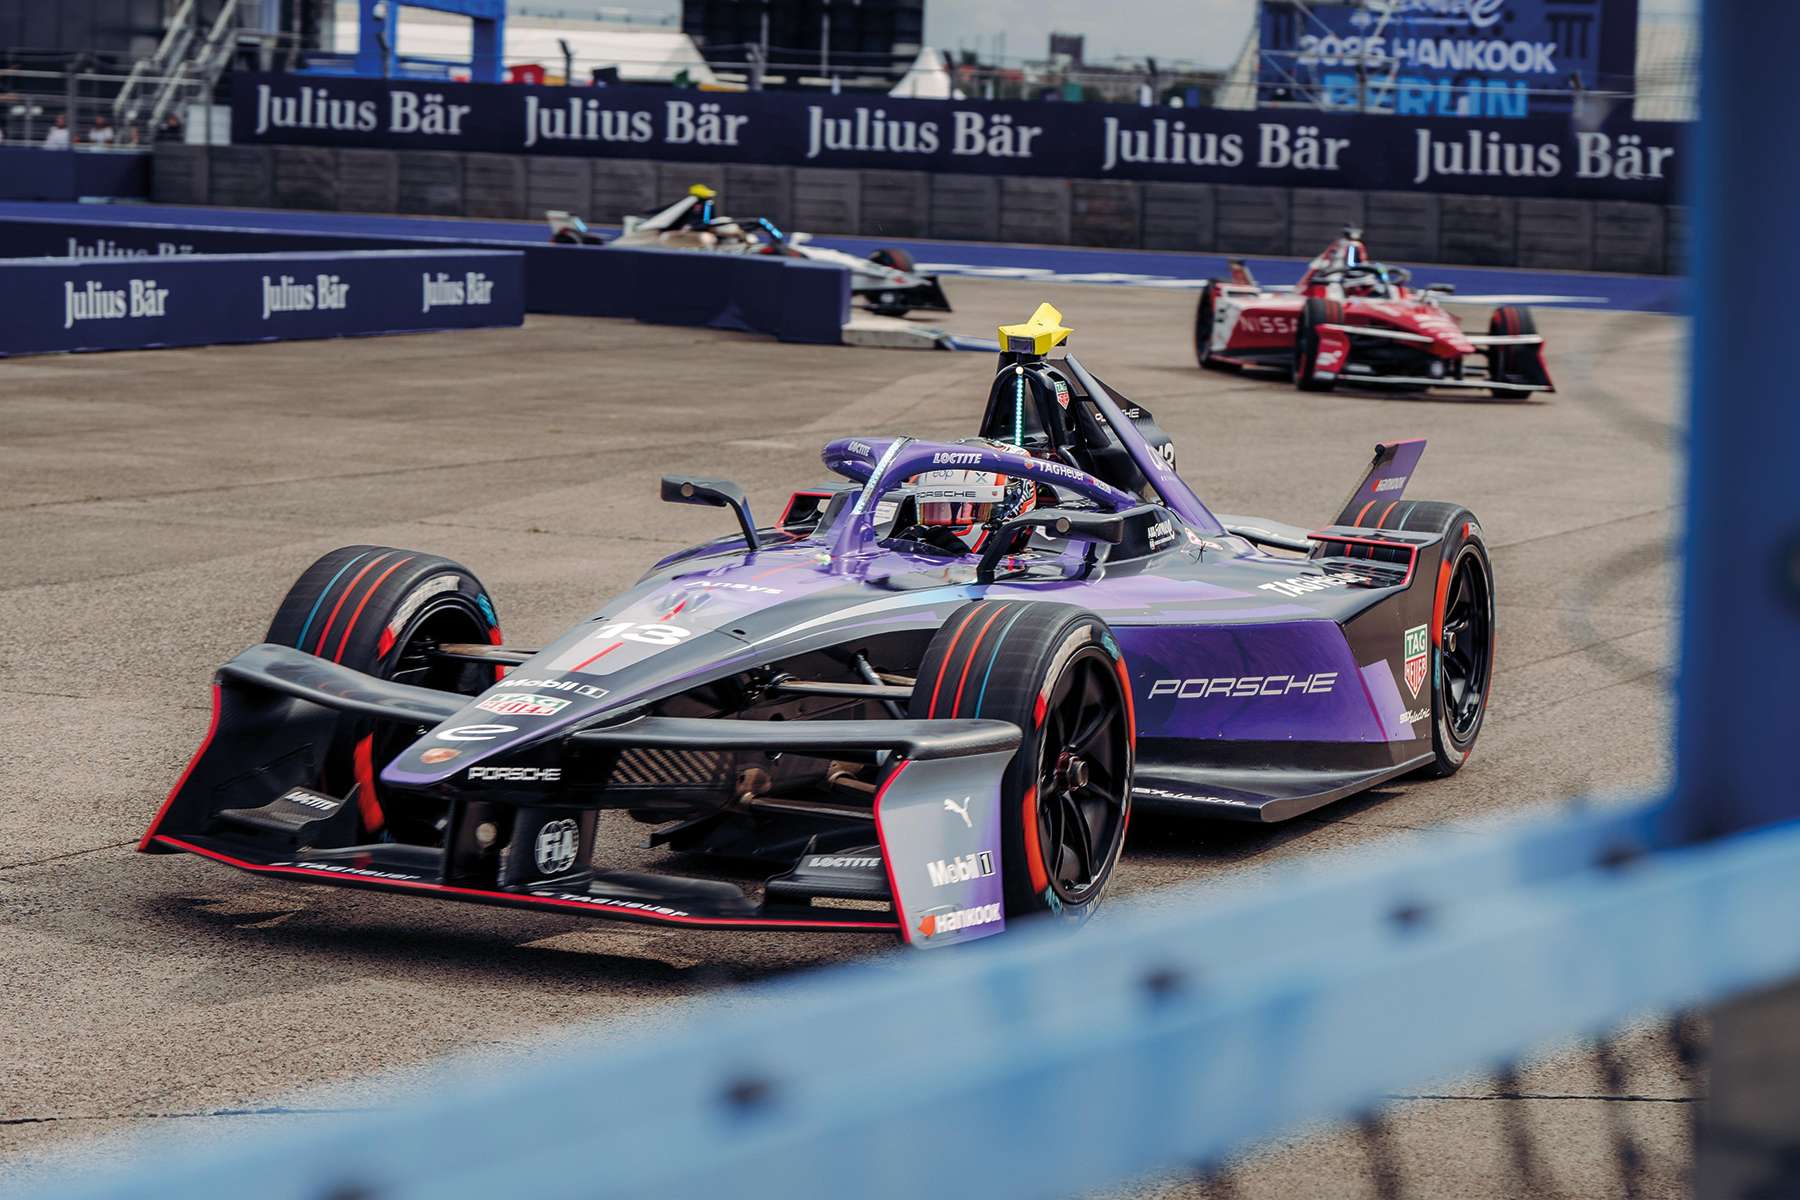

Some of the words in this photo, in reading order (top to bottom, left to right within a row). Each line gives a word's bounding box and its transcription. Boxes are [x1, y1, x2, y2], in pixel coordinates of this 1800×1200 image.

[1392, 38, 1557, 73] HANKOOK
[256, 84, 378, 135] Julius
[389, 91, 471, 135] Bär
[1323, 73, 1528, 117] BERLIN
[525, 96, 653, 147] Julius
[665, 101, 748, 146] Bär
[807, 105, 939, 158] Julius
[952, 111, 1043, 157] Bär
[1102, 117, 1244, 171] Julius
[1257, 123, 1350, 170] Bär
[1413, 129, 1562, 184] Julius
[1576, 131, 1675, 180] Bär
[64, 281, 127, 329] Julius
[129, 279, 169, 317] Bär
[262, 275, 316, 320] Julius
[317, 274, 350, 310] Bär
[422, 272, 466, 313] Julius
[466, 271, 494, 304] Bär
[848, 441, 872, 457] LOCTITE
[932, 452, 983, 464] LOCTITE
[684, 580, 784, 594] Ansys
[597, 622, 692, 646] 13
[1406, 630, 1426, 655] TAG
[497, 678, 579, 691] Mobil
[1148, 672, 1338, 700] PORSCHE
[468, 766, 562, 781] PORSCHE
[536, 830, 575, 865] FIA
[808, 857, 882, 868] LOCTITE
[926, 852, 980, 888] Mobil
